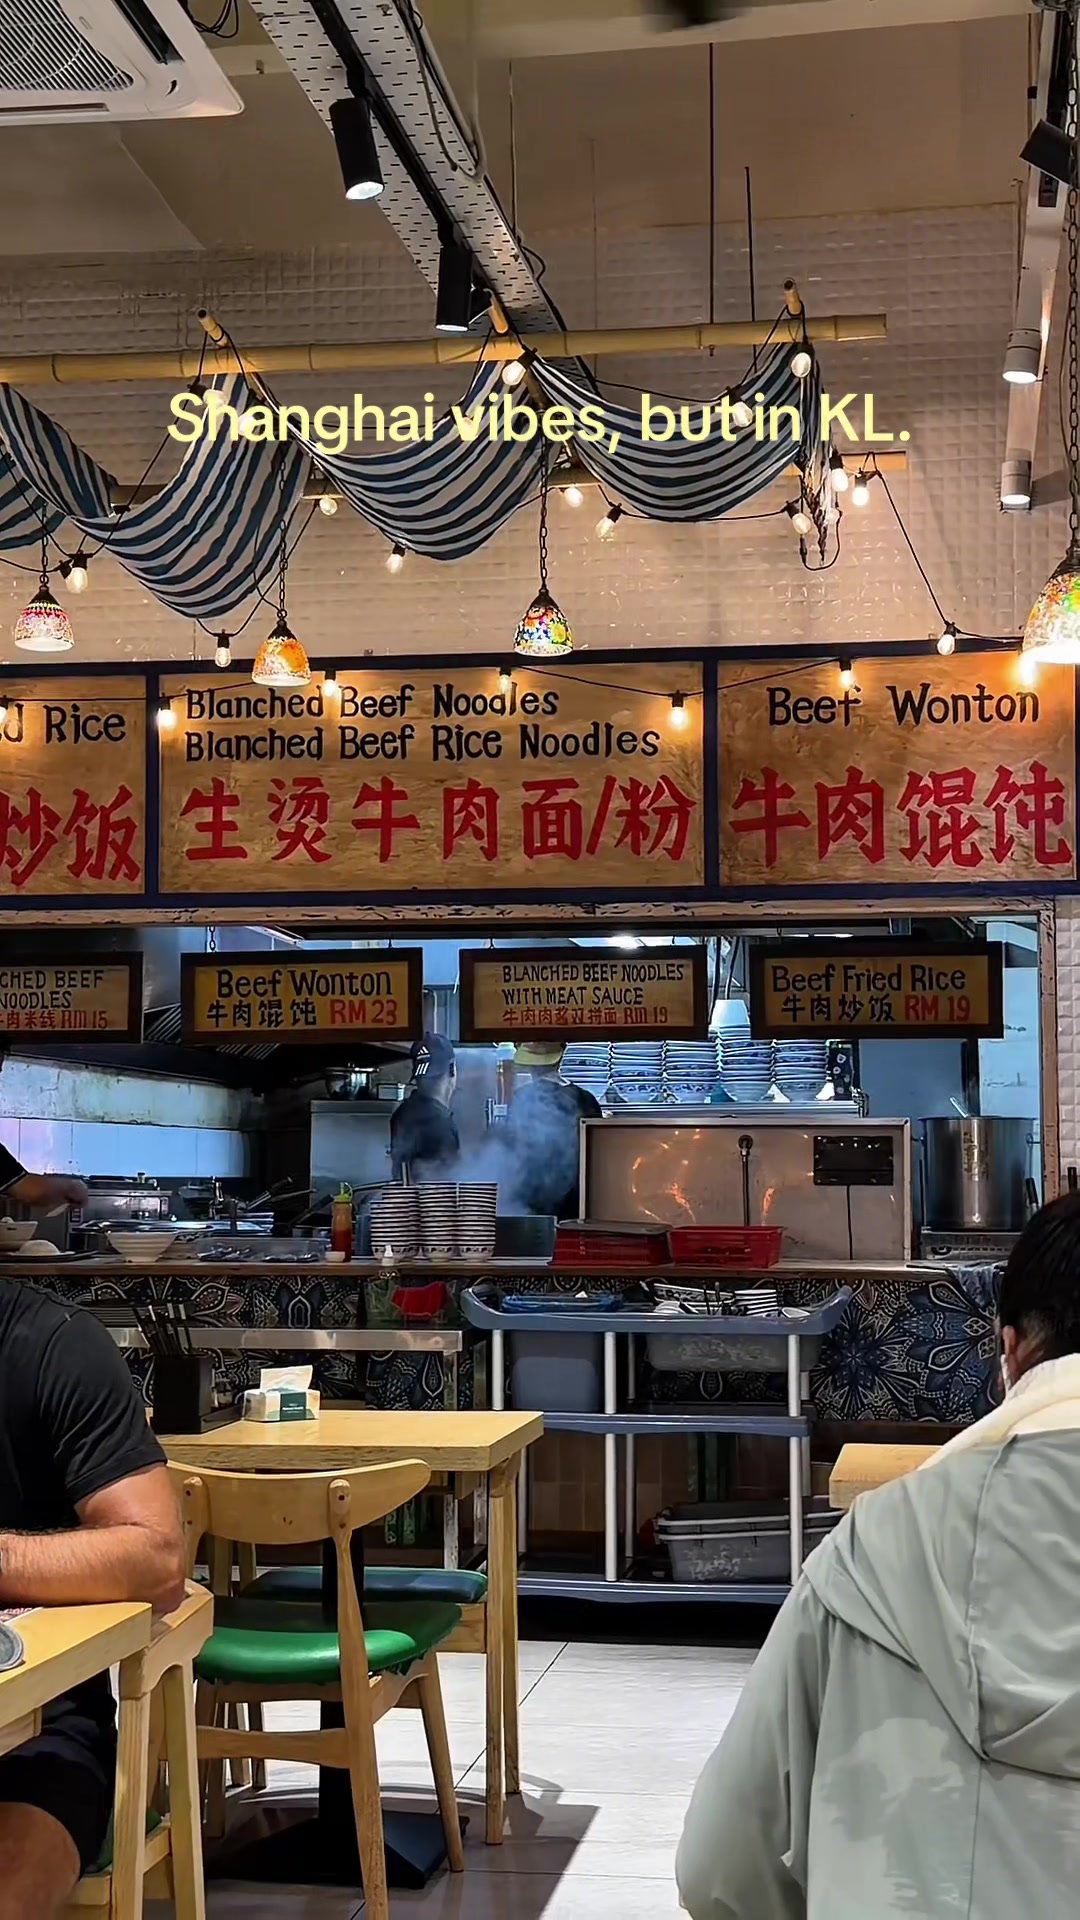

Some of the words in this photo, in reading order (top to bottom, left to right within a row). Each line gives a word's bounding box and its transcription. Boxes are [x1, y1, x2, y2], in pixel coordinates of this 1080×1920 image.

[186, 685, 324, 720] Blanched
[339, 684, 415, 718] Beef
[433, 681, 559, 718] Noodles
[766, 682, 862, 727] Beef
[886, 681, 1040, 726] Wonton
[43, 703, 126, 744] Rice
[185, 726, 324, 762] Blanched
[338, 723, 415, 760] Beef
[431, 723, 502, 762] Rice
[520, 720, 661, 759] Noodles
[179, 774, 697, 864] 生烫牛肉面/粉
[729, 760, 1072, 868] 牛肉馄饨
[0, 784, 141, 887] 炒饭
[0, 970, 46, 989] CHED
[55, 969, 104, 989] BEEF
[217, 968, 282, 999] Beef
[288, 969, 392, 997] Wonton
[503, 964, 579, 983] BLANCHED
[583, 963, 618, 982] BEEF
[622, 963, 685, 983] NOODLES
[772, 963, 836, 993] Beef
[843, 963, 902, 993] Fried
[502, 987, 541, 1006] WITH
[545, 986, 586, 1006] MEAT
[592, 987, 644, 1006] SAUCE
[781, 993, 895, 1023] 牛肉炒饭
[904, 994, 939, 1021] RM
[948, 994, 971, 1022] 19
[0, 1009, 56, 1030] 肉米线
[92, 1010, 108, 1029] 15
[206, 997, 317, 1028] 牛肉馄饨
[653, 1006, 668, 1024] 19
